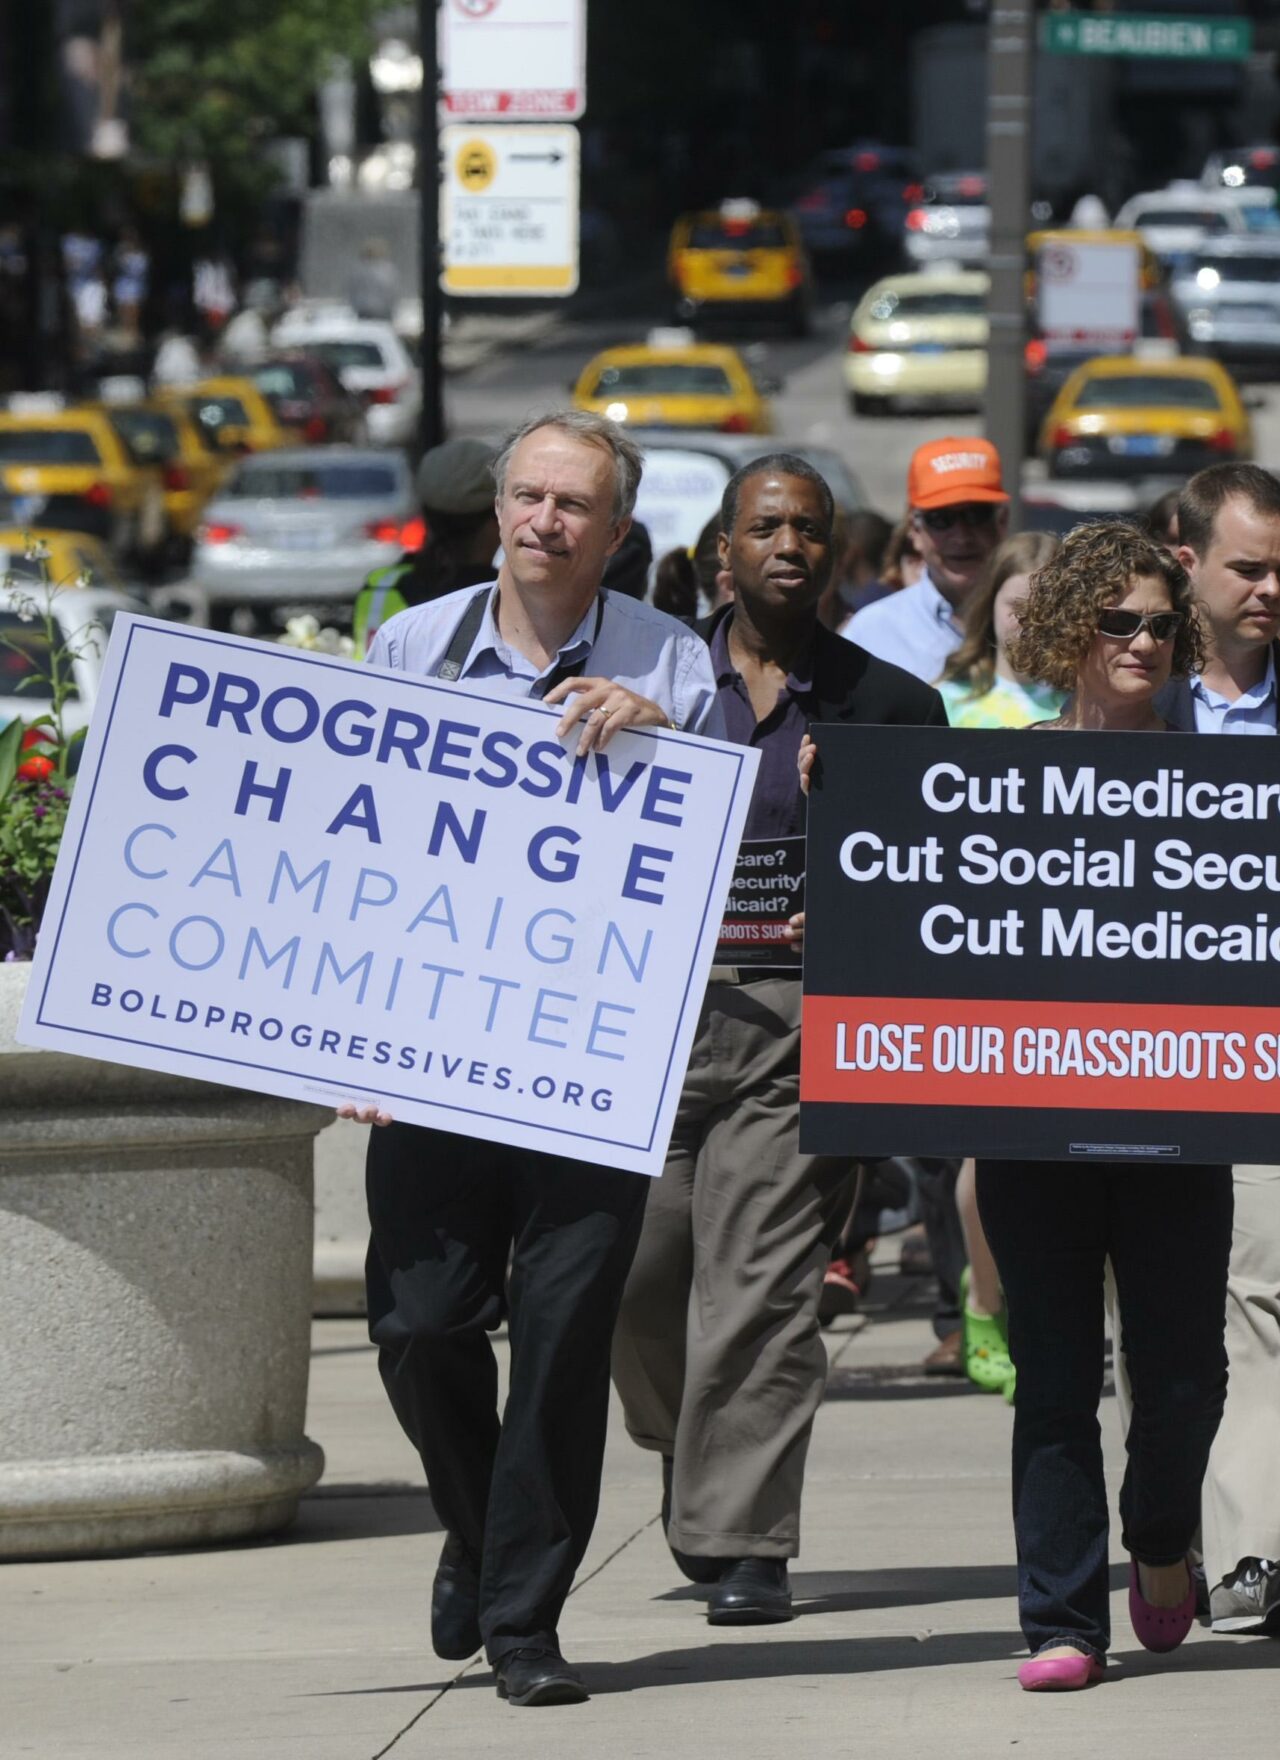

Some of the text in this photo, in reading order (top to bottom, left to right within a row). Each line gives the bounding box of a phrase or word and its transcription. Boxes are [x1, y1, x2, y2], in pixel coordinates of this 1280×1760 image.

[158, 662, 693, 828] PROGRESSIVE
[921, 762, 1025, 814] Cut
[143, 744, 674, 905] CHANGE
[838, 831, 944, 884] Cut
[958, 834, 1136, 888] Social
[123, 822, 654, 983] CAMPAIGN
[920, 904, 1024, 957] Cut
[91, 982, 614, 1113] BOLDPROGRESSIVES.ORG
[106, 902, 637, 1062] COMMITTEE
[835, 1022, 926, 1073] LOSE
[931, 1025, 1006, 1075] OUR
[1012, 1027, 1247, 1081] GRASSROOTS
